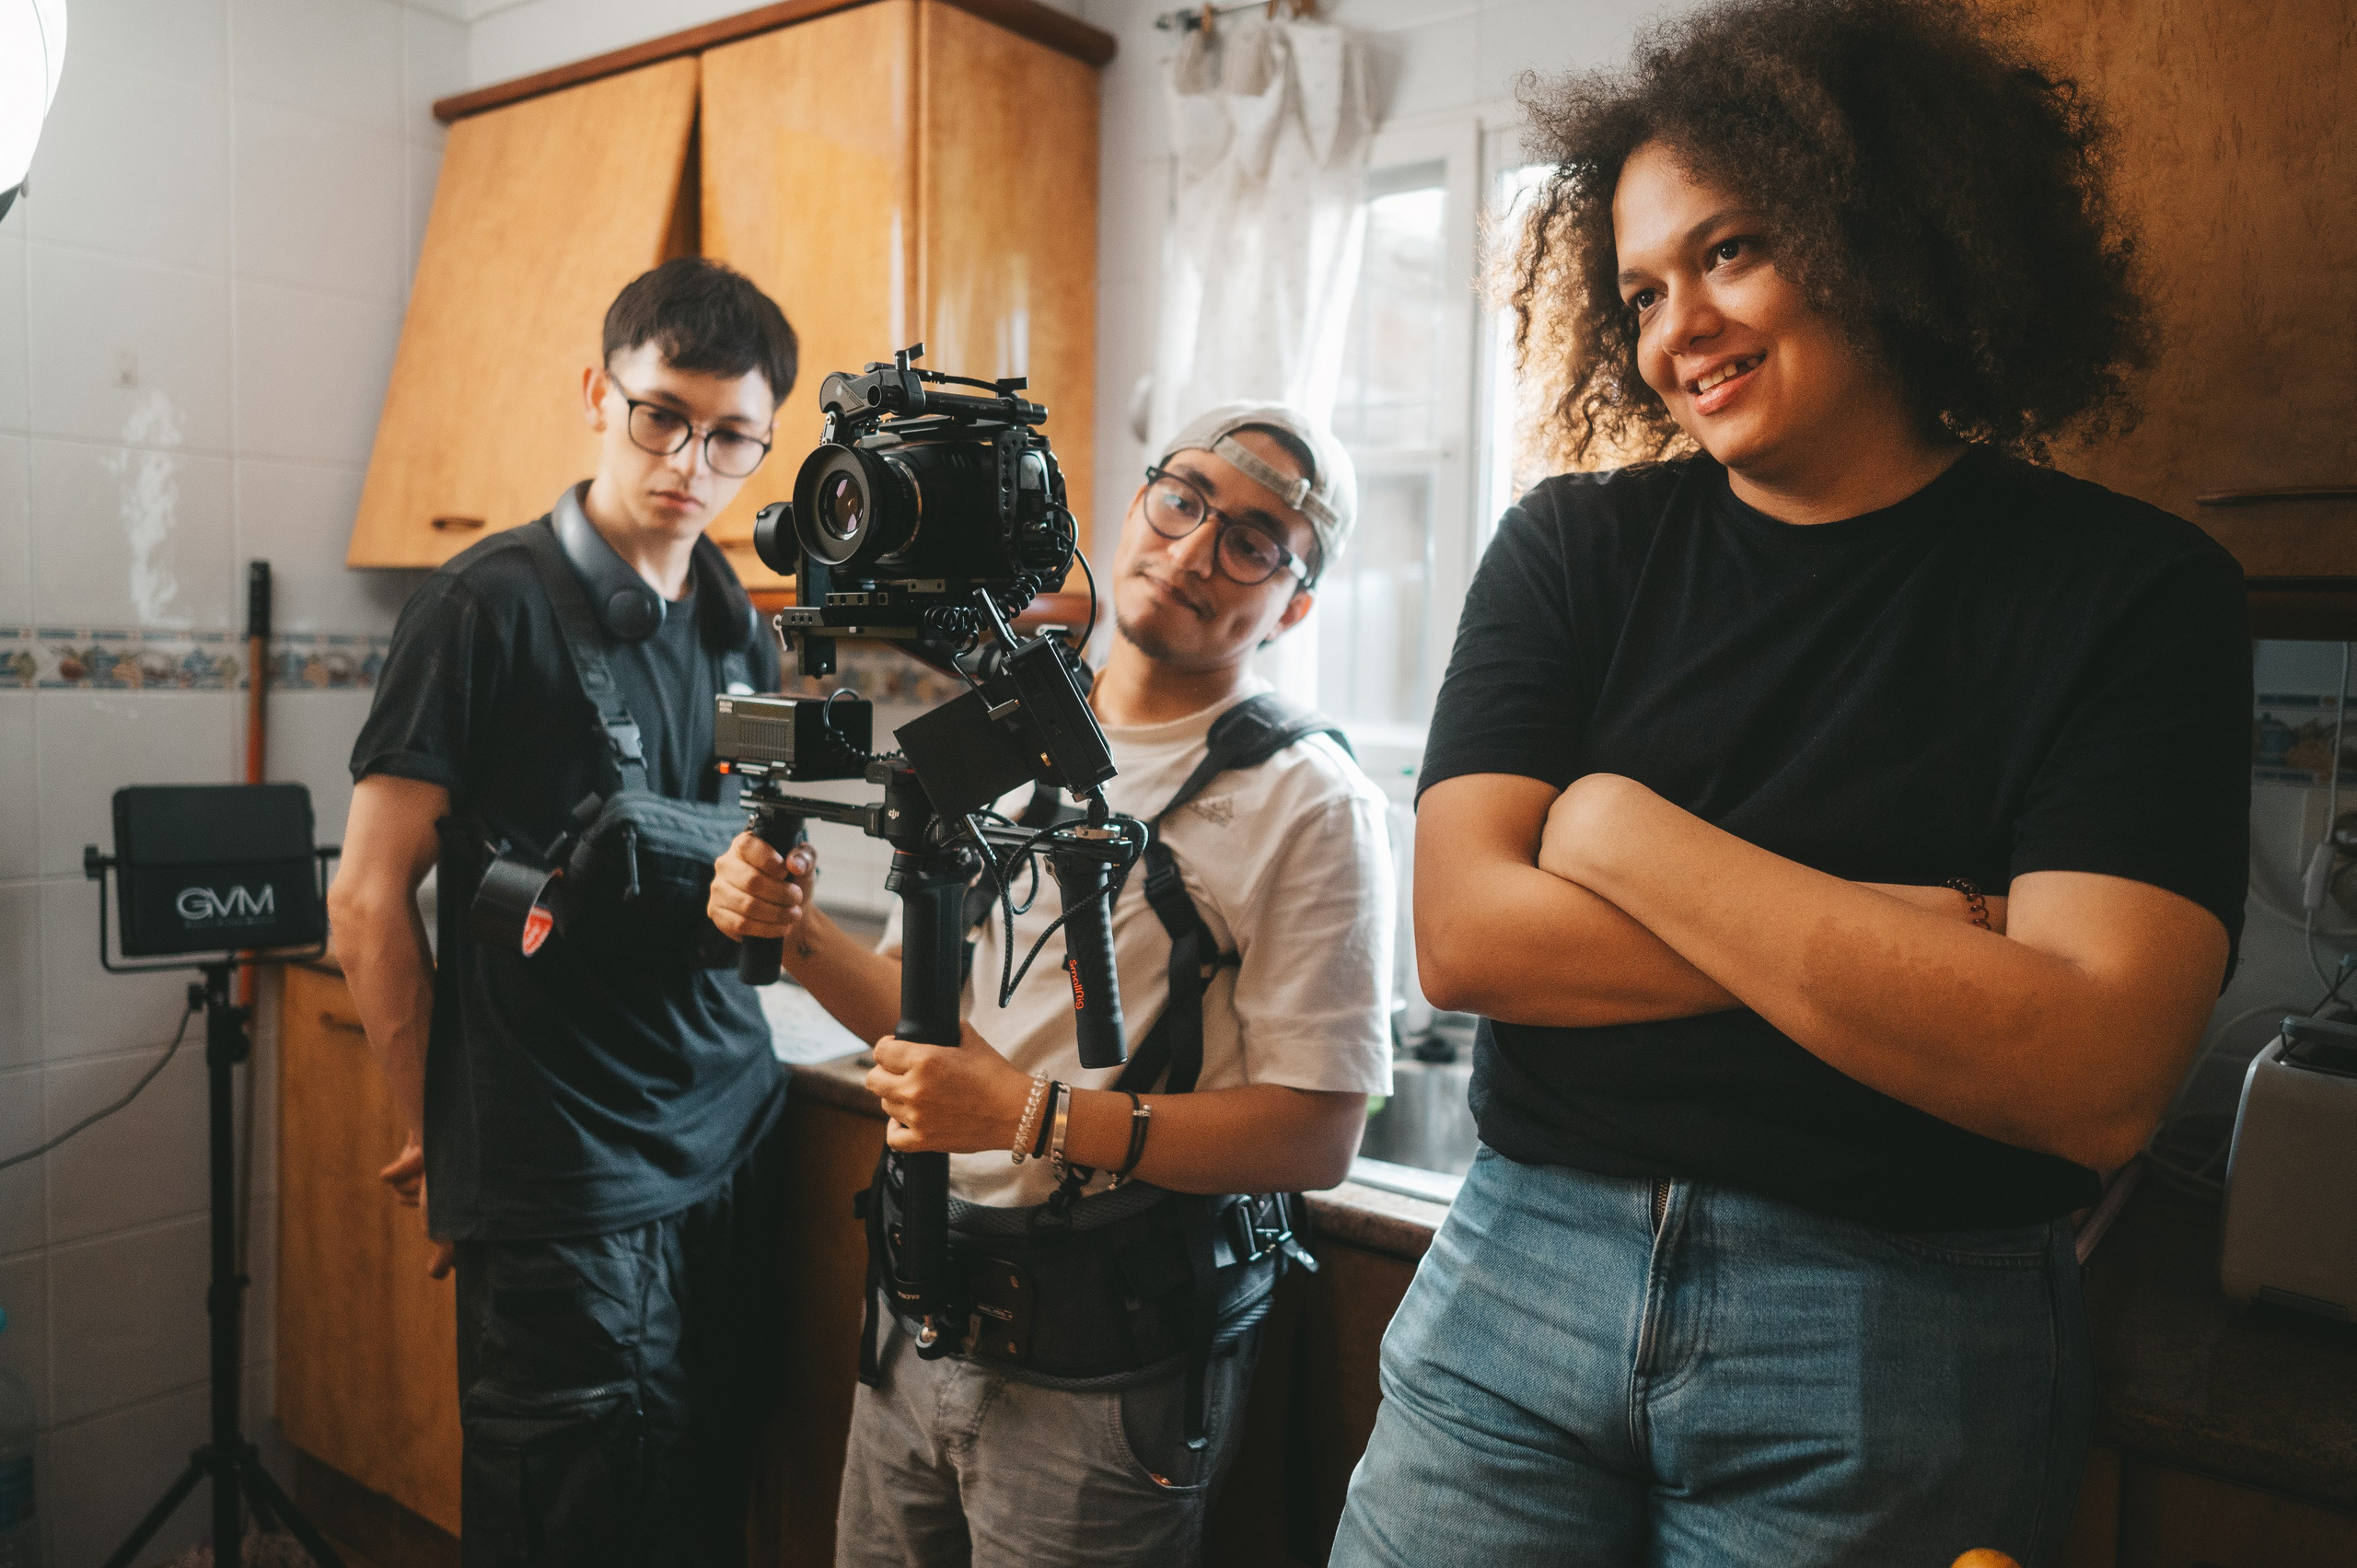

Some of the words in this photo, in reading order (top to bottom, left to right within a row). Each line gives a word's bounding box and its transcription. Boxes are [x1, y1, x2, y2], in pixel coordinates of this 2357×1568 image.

[888, 808, 900, 820] dji
[176, 883, 275, 920] GVM
[1068, 959, 1085, 1010] SmallRig
